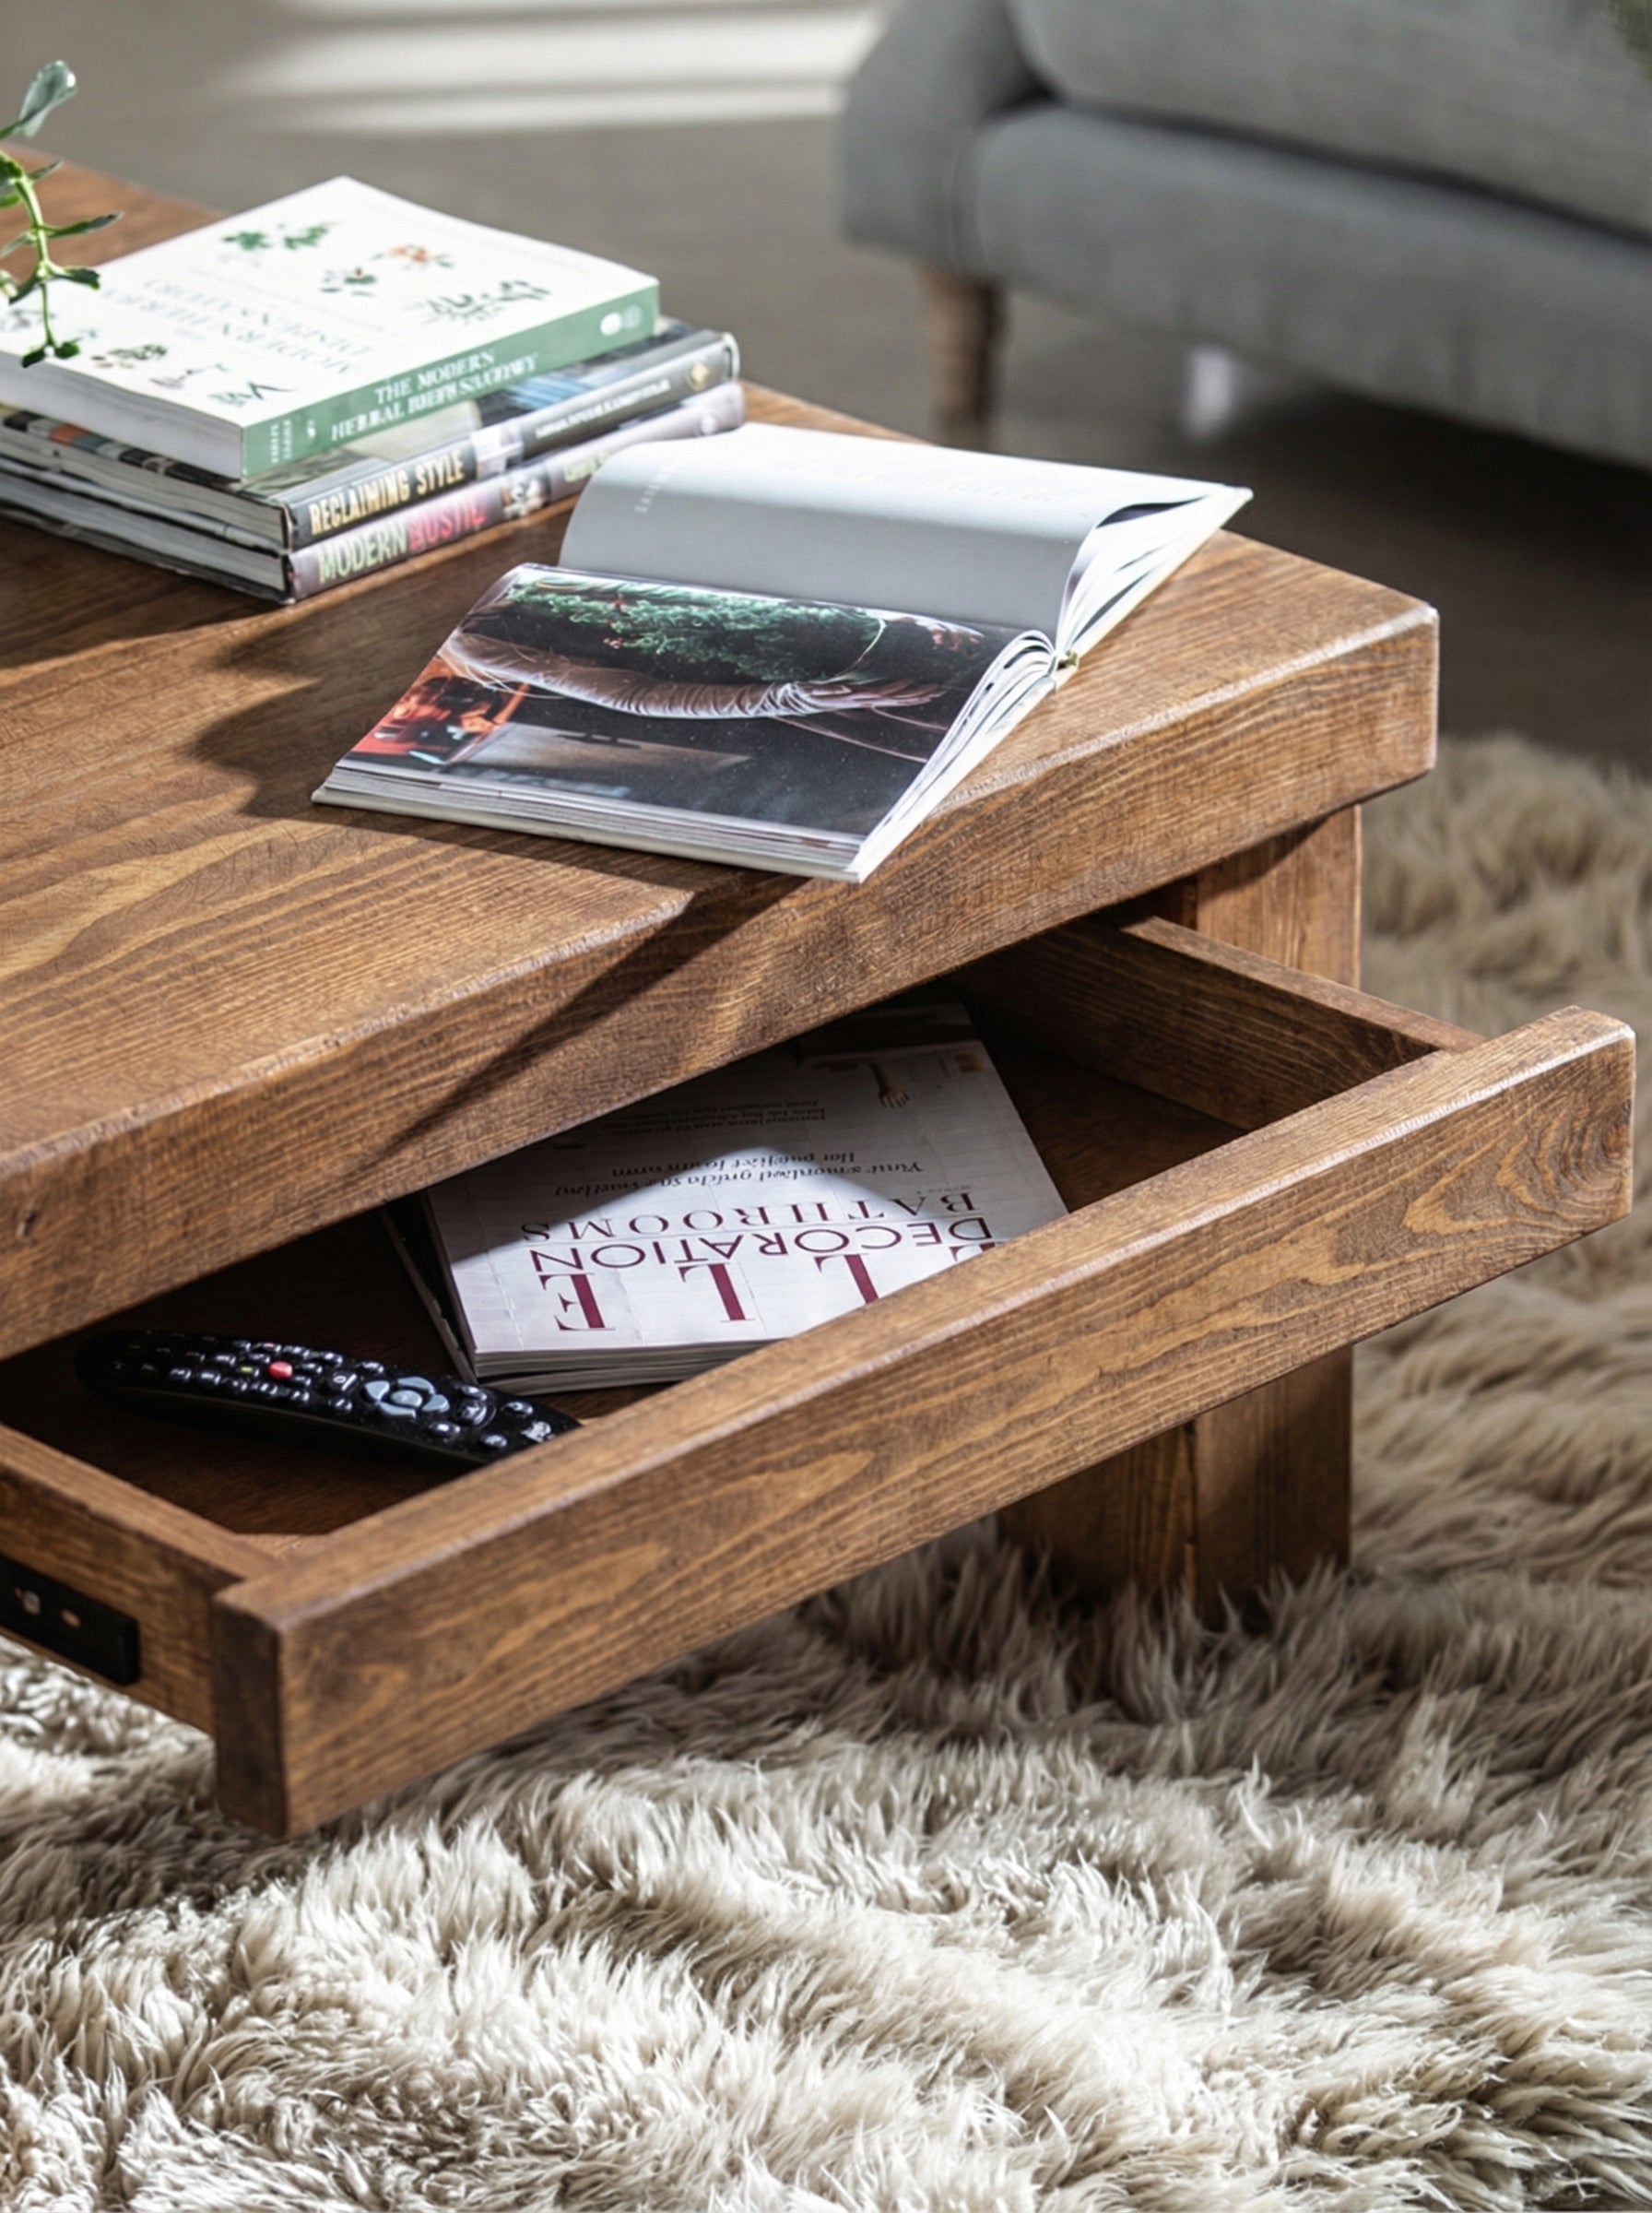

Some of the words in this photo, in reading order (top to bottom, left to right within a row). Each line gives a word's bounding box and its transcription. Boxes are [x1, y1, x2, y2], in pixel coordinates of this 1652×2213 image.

[374, 378, 413, 404] THE
[417, 349, 495, 390] MODERN
[309, 469, 410, 536] RECLAIMING
[416, 449, 466, 495] STYLE
[319, 521, 408, 584] MODERN
[521, 1192, 979, 1242] BATHROOMS
[530, 1216, 994, 1272] DECORATION
[538, 1241, 1009, 1331] LLE
